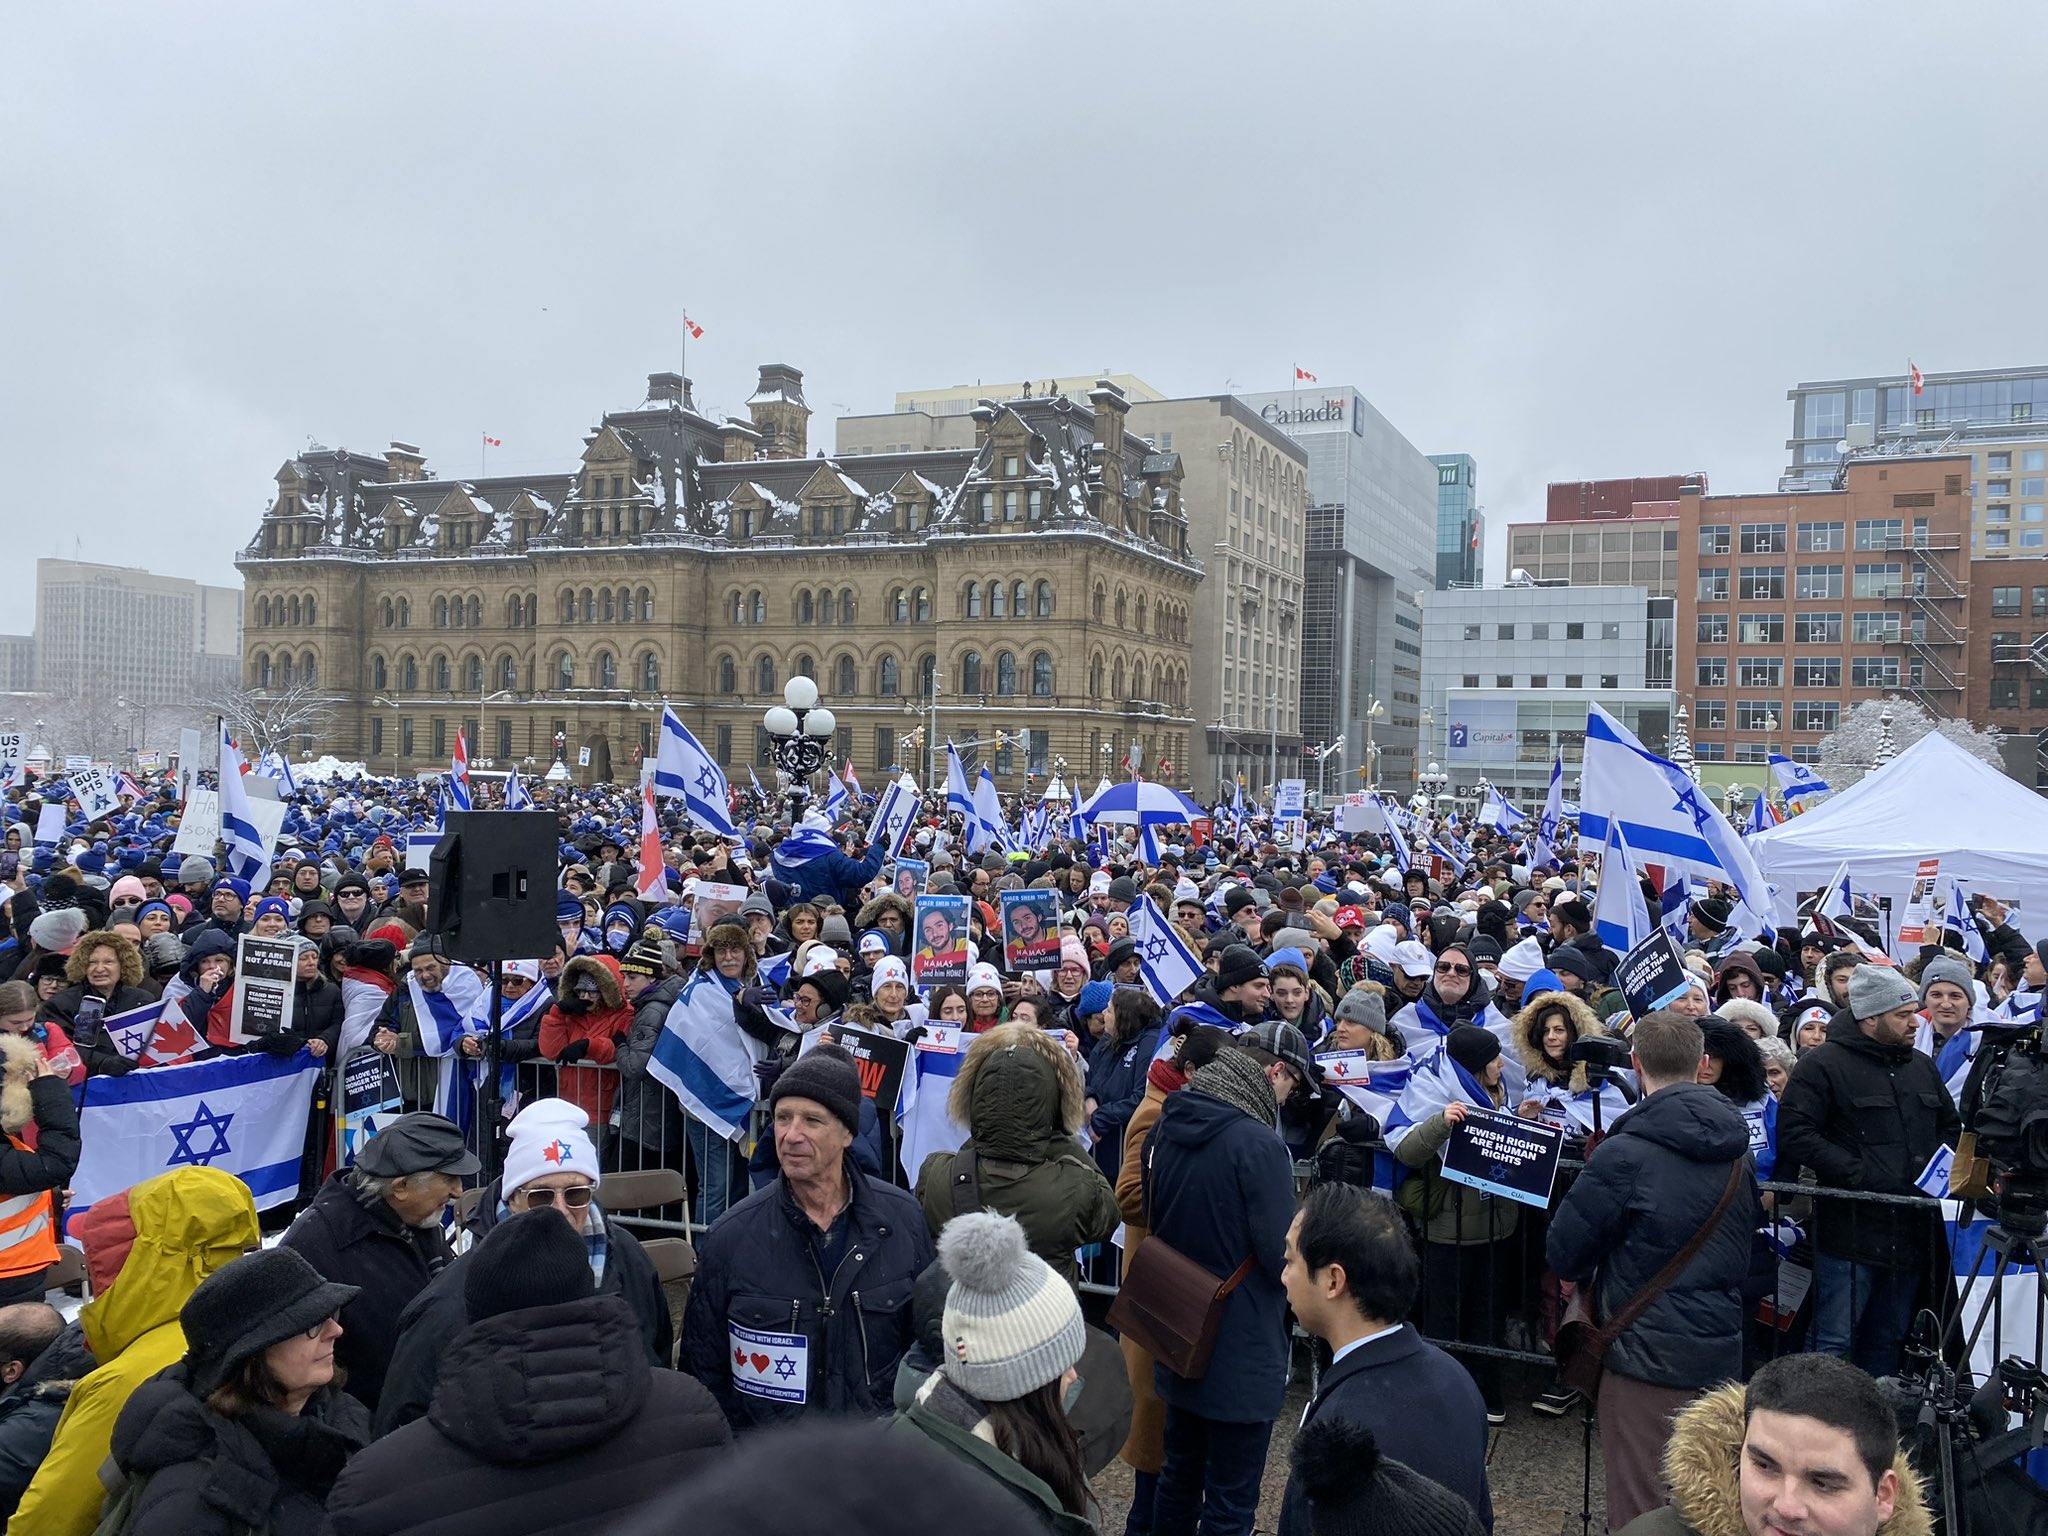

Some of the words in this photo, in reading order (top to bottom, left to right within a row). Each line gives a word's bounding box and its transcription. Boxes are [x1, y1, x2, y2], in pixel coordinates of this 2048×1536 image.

[1261, 400, 1343, 425] Canada
[0, 735, 20, 746] US
[0, 747, 18, 758] 12
[74, 768, 100, 787] BUS
[80, 779, 103, 796] #15
[1412, 854, 1432, 866] NEVER
[254, 950, 267, 958] WE
[1016, 948, 1046, 956] HAMAS
[245, 956, 261, 964] NOT
[262, 958, 292, 968] AFRAID
[924, 960, 954, 968] HAMAS
[1014, 956, 1028, 965] Send
[1028, 956, 1040, 964] him
[1040, 955, 1059, 964] HOME!
[920, 967, 934, 978] Send
[934, 968, 945, 978] him
[1626, 971, 1636, 984] OUR
[1634, 956, 1650, 974] LOVE
[1650, 951, 1658, 960] IS
[1625, 966, 1651, 996] STRONGER
[1650, 952, 1670, 969] THAN
[1631, 978, 1646, 996] THEIR
[1645, 966, 1664, 982] HATE
[248, 990, 267, 998] STAND
[841, 1034, 860, 1046] BRING
[854, 1046, 872, 1060] HOME
[356, 1069, 371, 1080] LOVE
[371, 1067, 380, 1075] IS
[854, 1057, 887, 1091] OW
[348, 1086, 364, 1096] THEIR
[1494, 1116, 1514, 1127] RALLY
[1464, 1125, 1504, 1143] JEWISH
[1506, 1136, 1547, 1154] RIGHTS
[1470, 1136, 1494, 1149] ARE
[1494, 1142, 1537, 1160] HUMAN
[1481, 1148, 1522, 1166] RIGHTS
[740, 1331, 756, 1341] STAND
[756, 1336, 772, 1344] WITH
